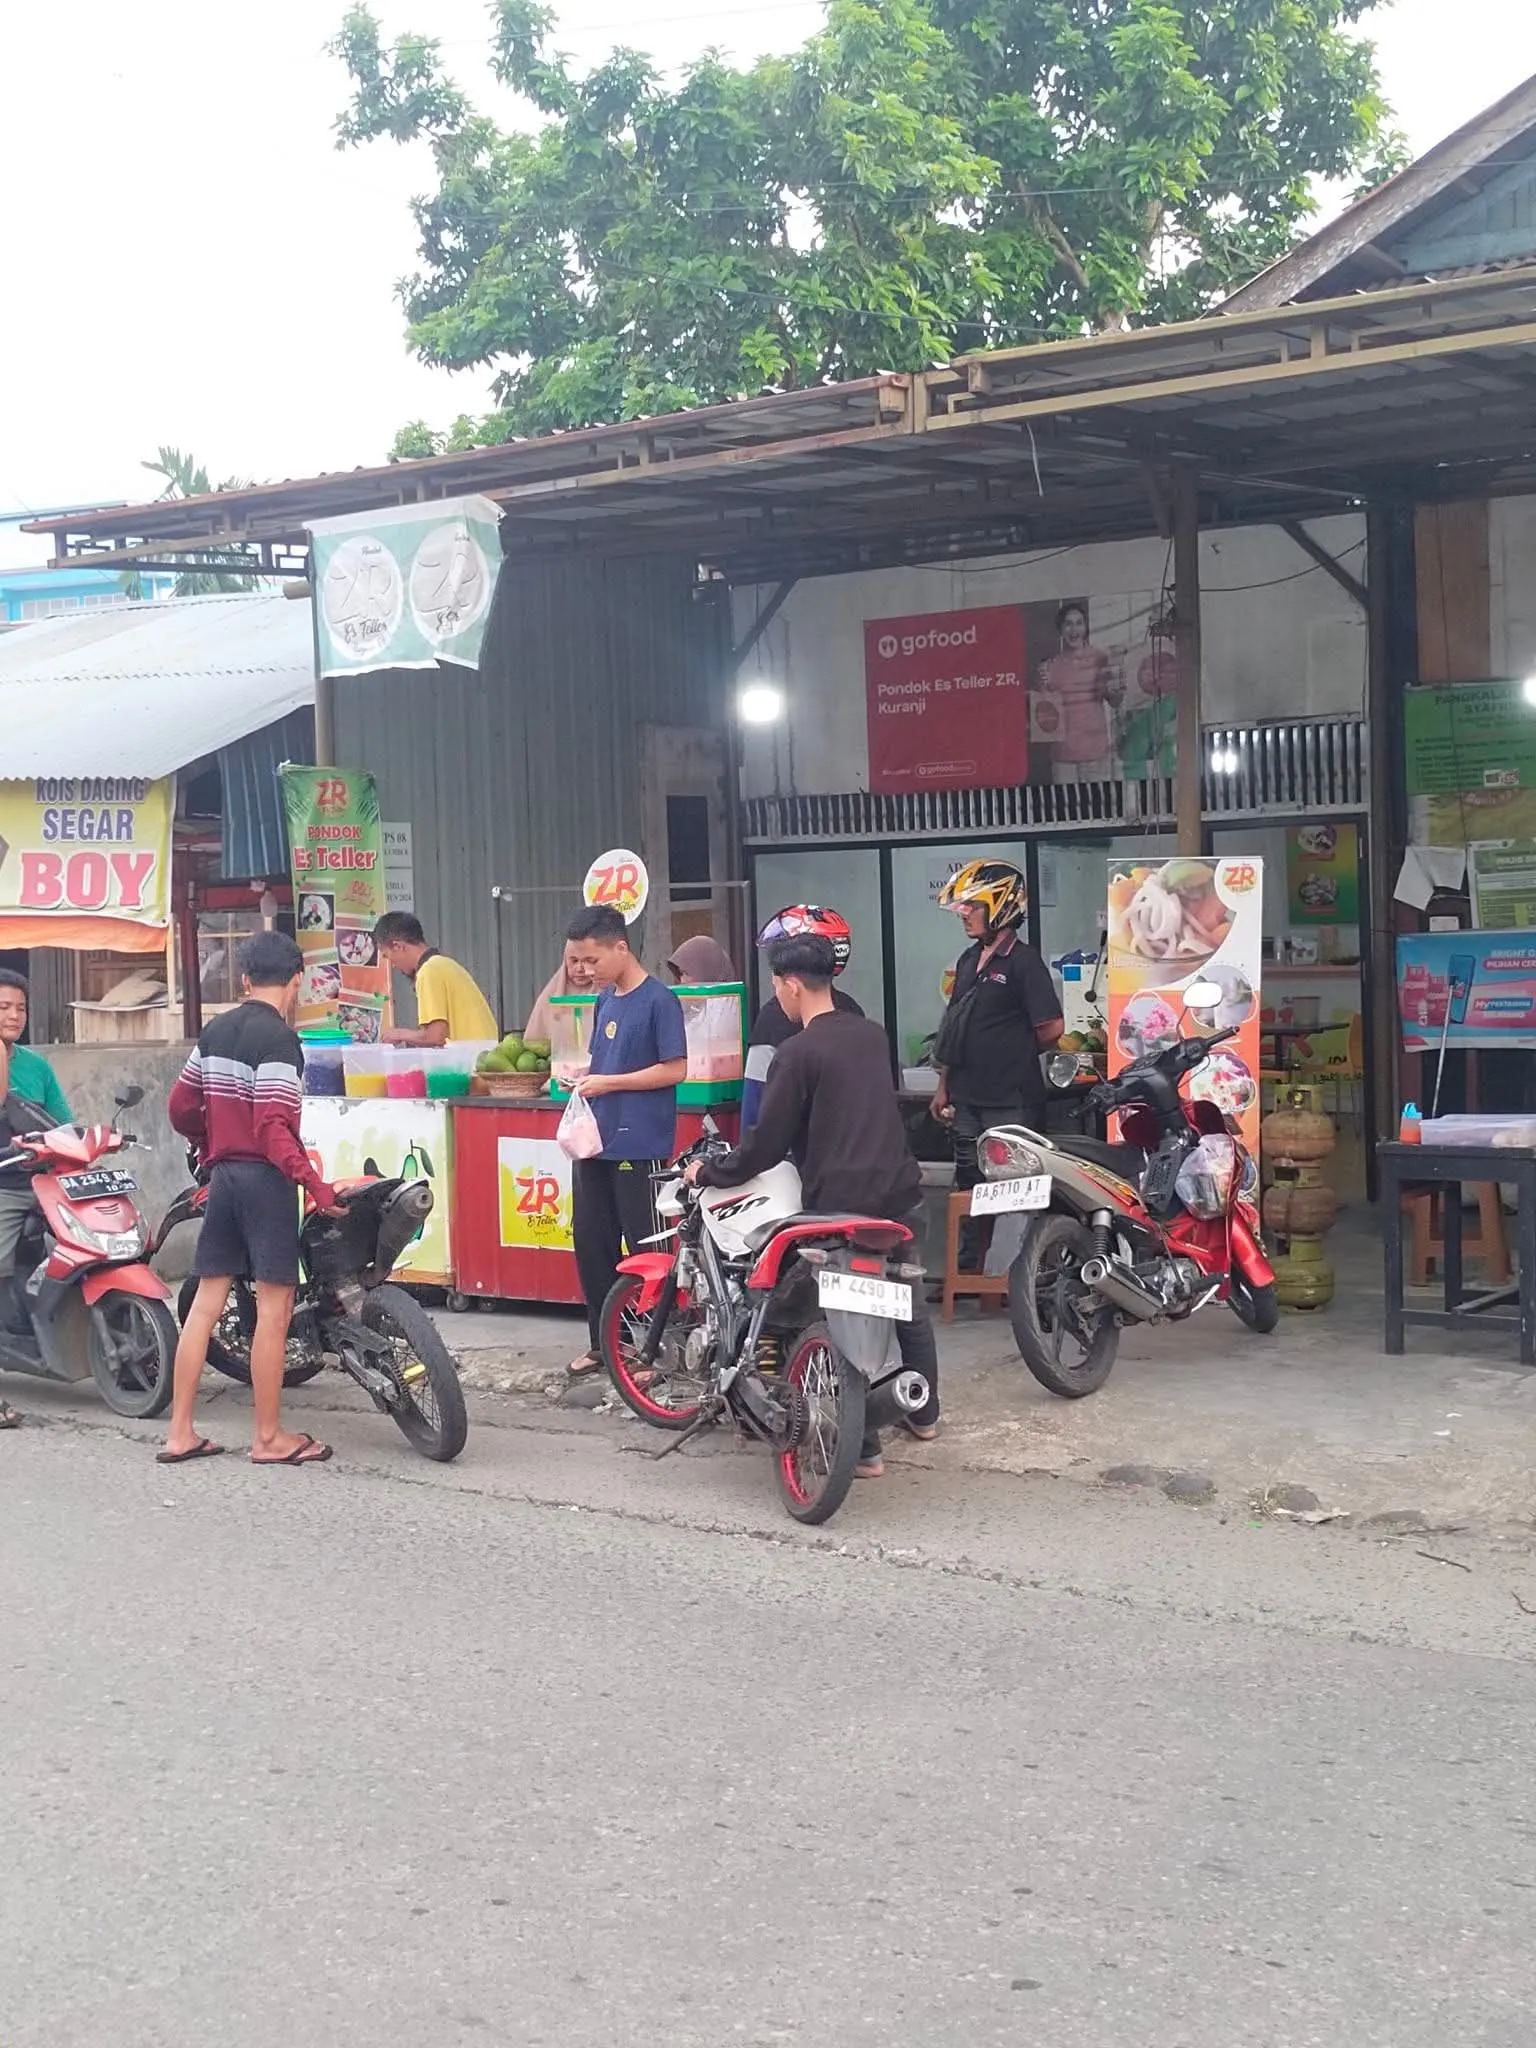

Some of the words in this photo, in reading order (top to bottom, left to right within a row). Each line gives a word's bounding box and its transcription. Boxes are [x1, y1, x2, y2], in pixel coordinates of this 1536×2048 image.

[901, 625, 977, 655] gofood
[878, 680, 931, 697] Pondok
[935, 679, 951, 692] Es
[954, 675, 992, 690] Teller
[995, 672, 1020, 687] ZR,
[878, 698, 926, 715] Kuranji
[81, 778, 144, 801] DAGING
[317, 779, 347, 806] ZR
[43, 808, 134, 841] SEGAR
[307, 826, 361, 839] PONDOK
[316, 846, 376, 869] Teller
[946, 863, 963, 873] AD
[20, 852, 154, 907] BOY
[591, 864, 640, 904] ZR
[929, 880, 949, 889] KO
[1224, 865, 1255, 887] ZR
[515, 1177, 560, 1215] ZR
[975, 1185, 988, 1200] BA
[992, 1181, 1020, 1198] 6710
[821, 1273, 841, 1290] BM
[849, 1278, 885, 1298] 4490
[893, 1284, 910, 1302] IK
